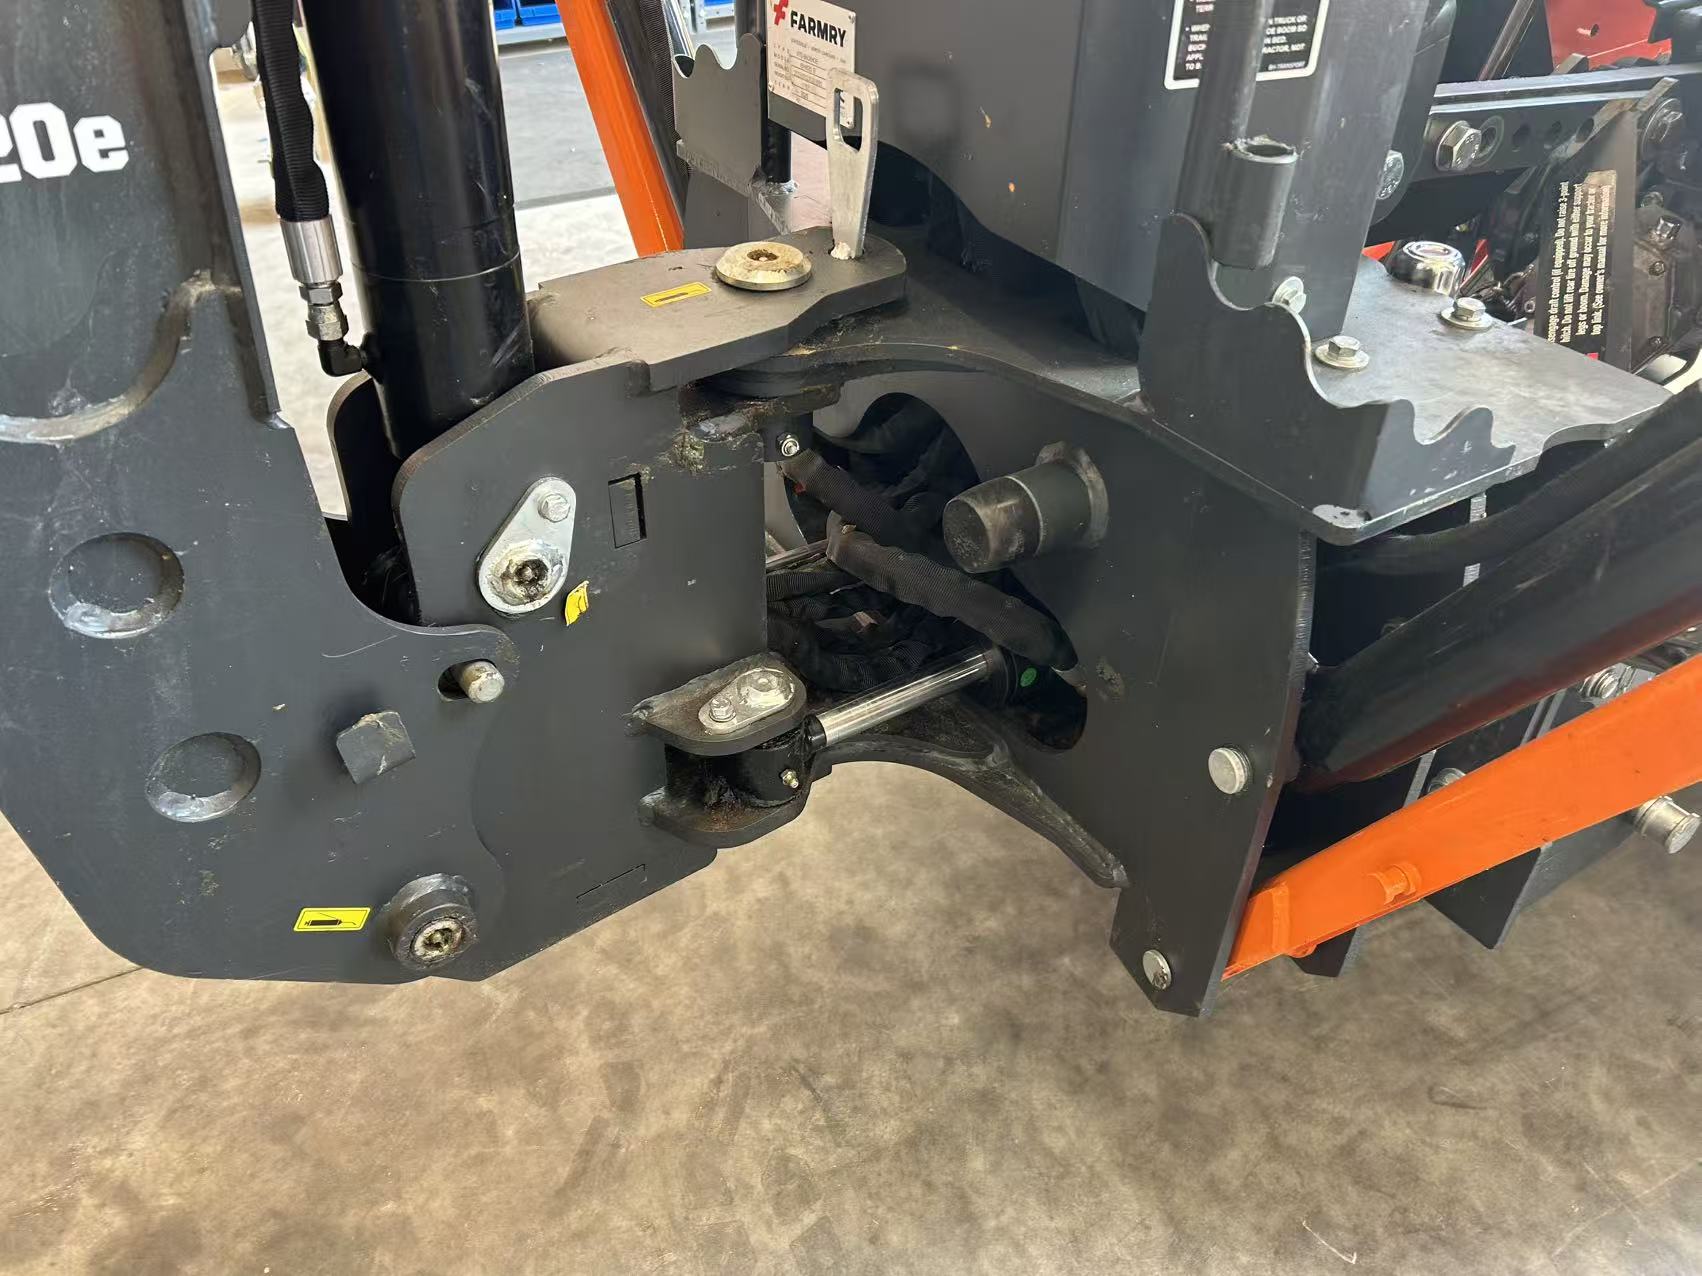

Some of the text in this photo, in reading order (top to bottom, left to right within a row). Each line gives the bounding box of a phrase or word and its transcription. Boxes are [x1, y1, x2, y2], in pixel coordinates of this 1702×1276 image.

[1297, 15, 1307, 23] OR
[790, 10, 846, 47] FARMRY
[1277, 26, 1297, 34] BOOM
[1291, 43, 1306, 51] NOT
[1185, 63, 1194, 71] TO
[1559, 181, 1570, 202] 3-point
[1573, 184, 1583, 205] support
[1557, 203, 1567, 217] raise
[1585, 195, 1595, 214] tractor
[1571, 206, 1580, 222] either
[1557, 218, 1566, 227] not
[1586, 215, 1595, 228] your
[1554, 229, 1565, 237] Do
[1570, 223, 1579, 236] with
[1599, 221, 1608, 236] more
[1597, 237, 1607, 245] for
[1569, 238, 1579, 258] ground
[1582, 254, 1593, 266] may
[1597, 246, 1606, 269] manual
[1566, 280, 1575, 292] rear
[1579, 268, 1592, 292] Damage
[1595, 269, 1604, 293] owner's
[1550, 277, 1561, 298] control
[1564, 293, 1574, 302] lift
[1577, 293, 1589, 312] boom.
[1592, 295, 1605, 308] (See
[1549, 299, 1559, 313] draft
[1564, 303, 1573, 314] not
[1562, 315, 1572, 324] Do
[1591, 309, 1602, 323] link.
[1575, 322, 1588, 335] legs
[1591, 324, 1603, 335] top
